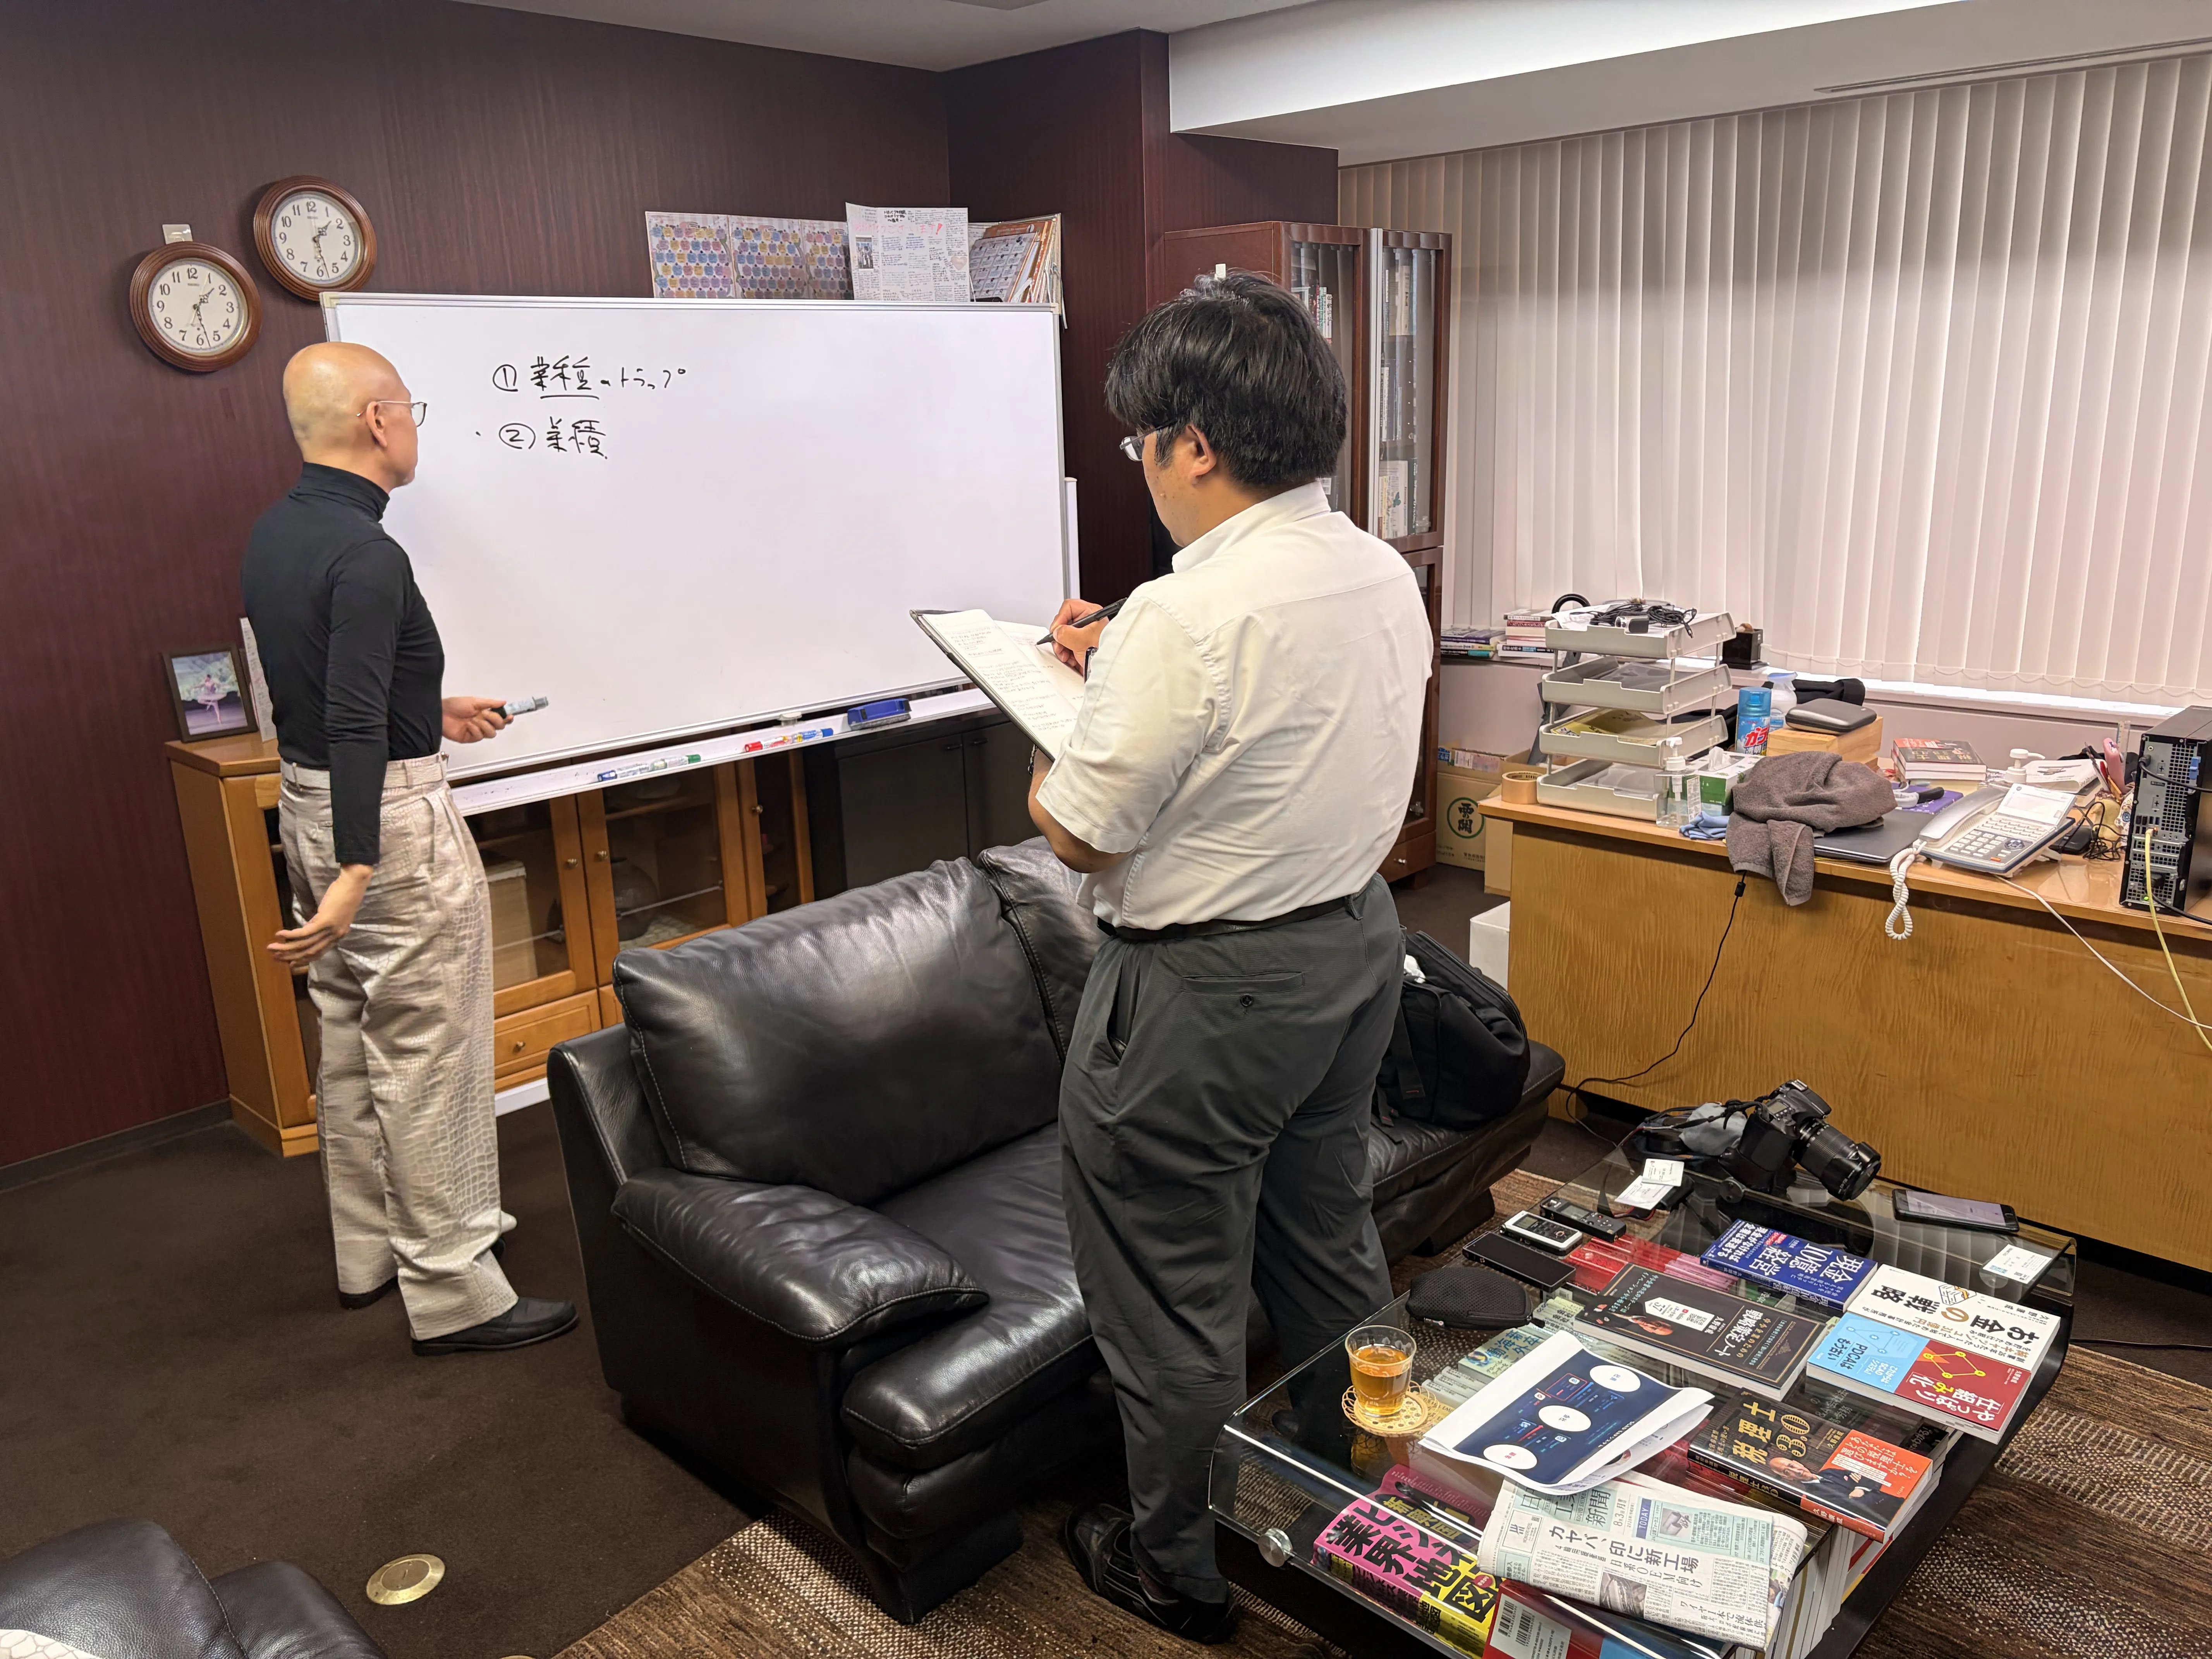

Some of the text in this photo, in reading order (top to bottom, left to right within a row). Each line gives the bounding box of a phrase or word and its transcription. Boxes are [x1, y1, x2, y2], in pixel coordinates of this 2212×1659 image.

[292, 204, 301, 216] 11
[306, 201, 316, 213] 12
[325, 207, 329, 217] 1
[282, 216, 291, 228] 10
[336, 218, 344, 229] 2
[279, 233, 287, 244] 9
[343, 235, 351, 246] 3
[287, 248, 294, 259] 8
[341, 251, 348, 262] 4
[187, 268, 198, 279] 12
[301, 262, 308, 273] 7
[317, 266, 324, 277] 6
[331, 263, 338, 274] 5
[172, 272, 180, 283] 11
[208, 273, 211, 283] 1
[160, 284, 170, 295] 10
[219, 285, 227, 295] 2
[157, 301, 165, 312] 9
[226, 302, 234, 313] 3
[164, 318, 173, 329] 8
[223, 318, 231, 329] 4
[179, 330, 187, 342] 7
[196, 335, 204, 346] 6
[213, 331, 220, 342] 5
[1727, 1226, 1768, 1262] 現金がなければ
[1746, 1245, 1793, 1278] 経営
[1786, 1242, 1833, 1276] 10億
[1819, 1253, 1865, 1287] 現金
[1711, 1308, 1765, 1359] 戦略策定ノート
[1823, 1337, 1852, 1362] もう古い
[1874, 1362, 1888, 1376] SCAD
[1908, 1372, 2002, 1413] 仕組み化
[1912, 1387, 1996, 1424] やっぱり
[1731, 1401, 1777, 1466] 税理士
[1776, 1414, 1810, 1458] 3.0
[1848, 1435, 1898, 1458] あなたは
[1843, 1440, 1920, 1475] どの税理士を
[1584, 1488, 1613, 1527] 新聞
[1576, 1507, 1584, 1522] KOGYO
[1638, 1507, 1650, 1529] TODAY
[1546, 1524, 1700, 1575] カヤバ、印に新工場
[1326, 1509, 1499, 1625] 業界地図
[1610, 1559, 1704, 1589] 日系OEM向け
[1678, 1600, 1768, 1630] ワイヤ1本で流体供
